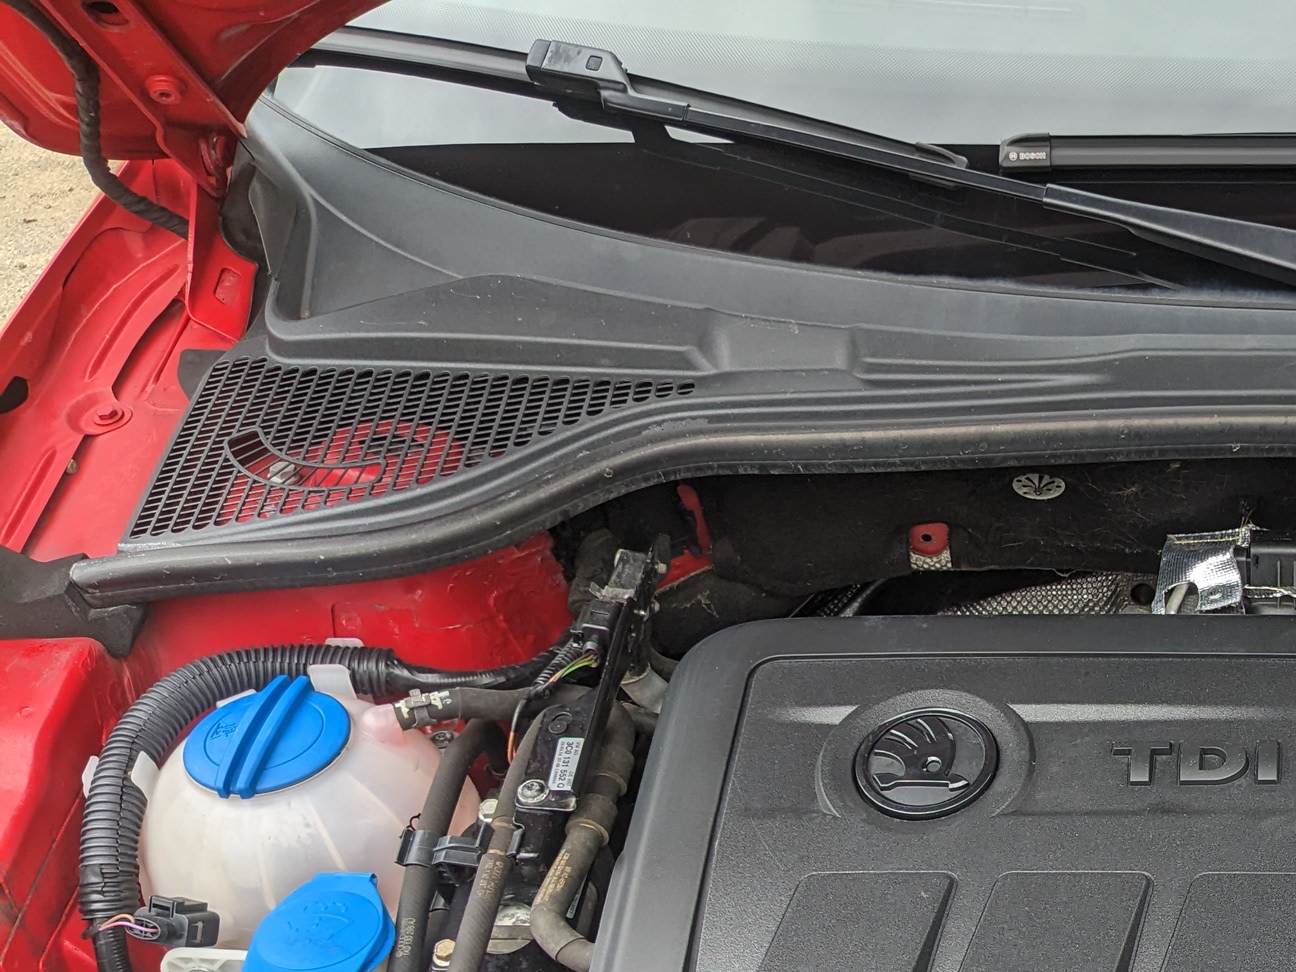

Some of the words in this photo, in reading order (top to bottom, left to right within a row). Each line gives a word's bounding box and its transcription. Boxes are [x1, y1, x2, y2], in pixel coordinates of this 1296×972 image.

[562, 756, 571, 767] 131
[1111, 740, 1281, 786] TDI
[558, 769, 567, 782] 552
